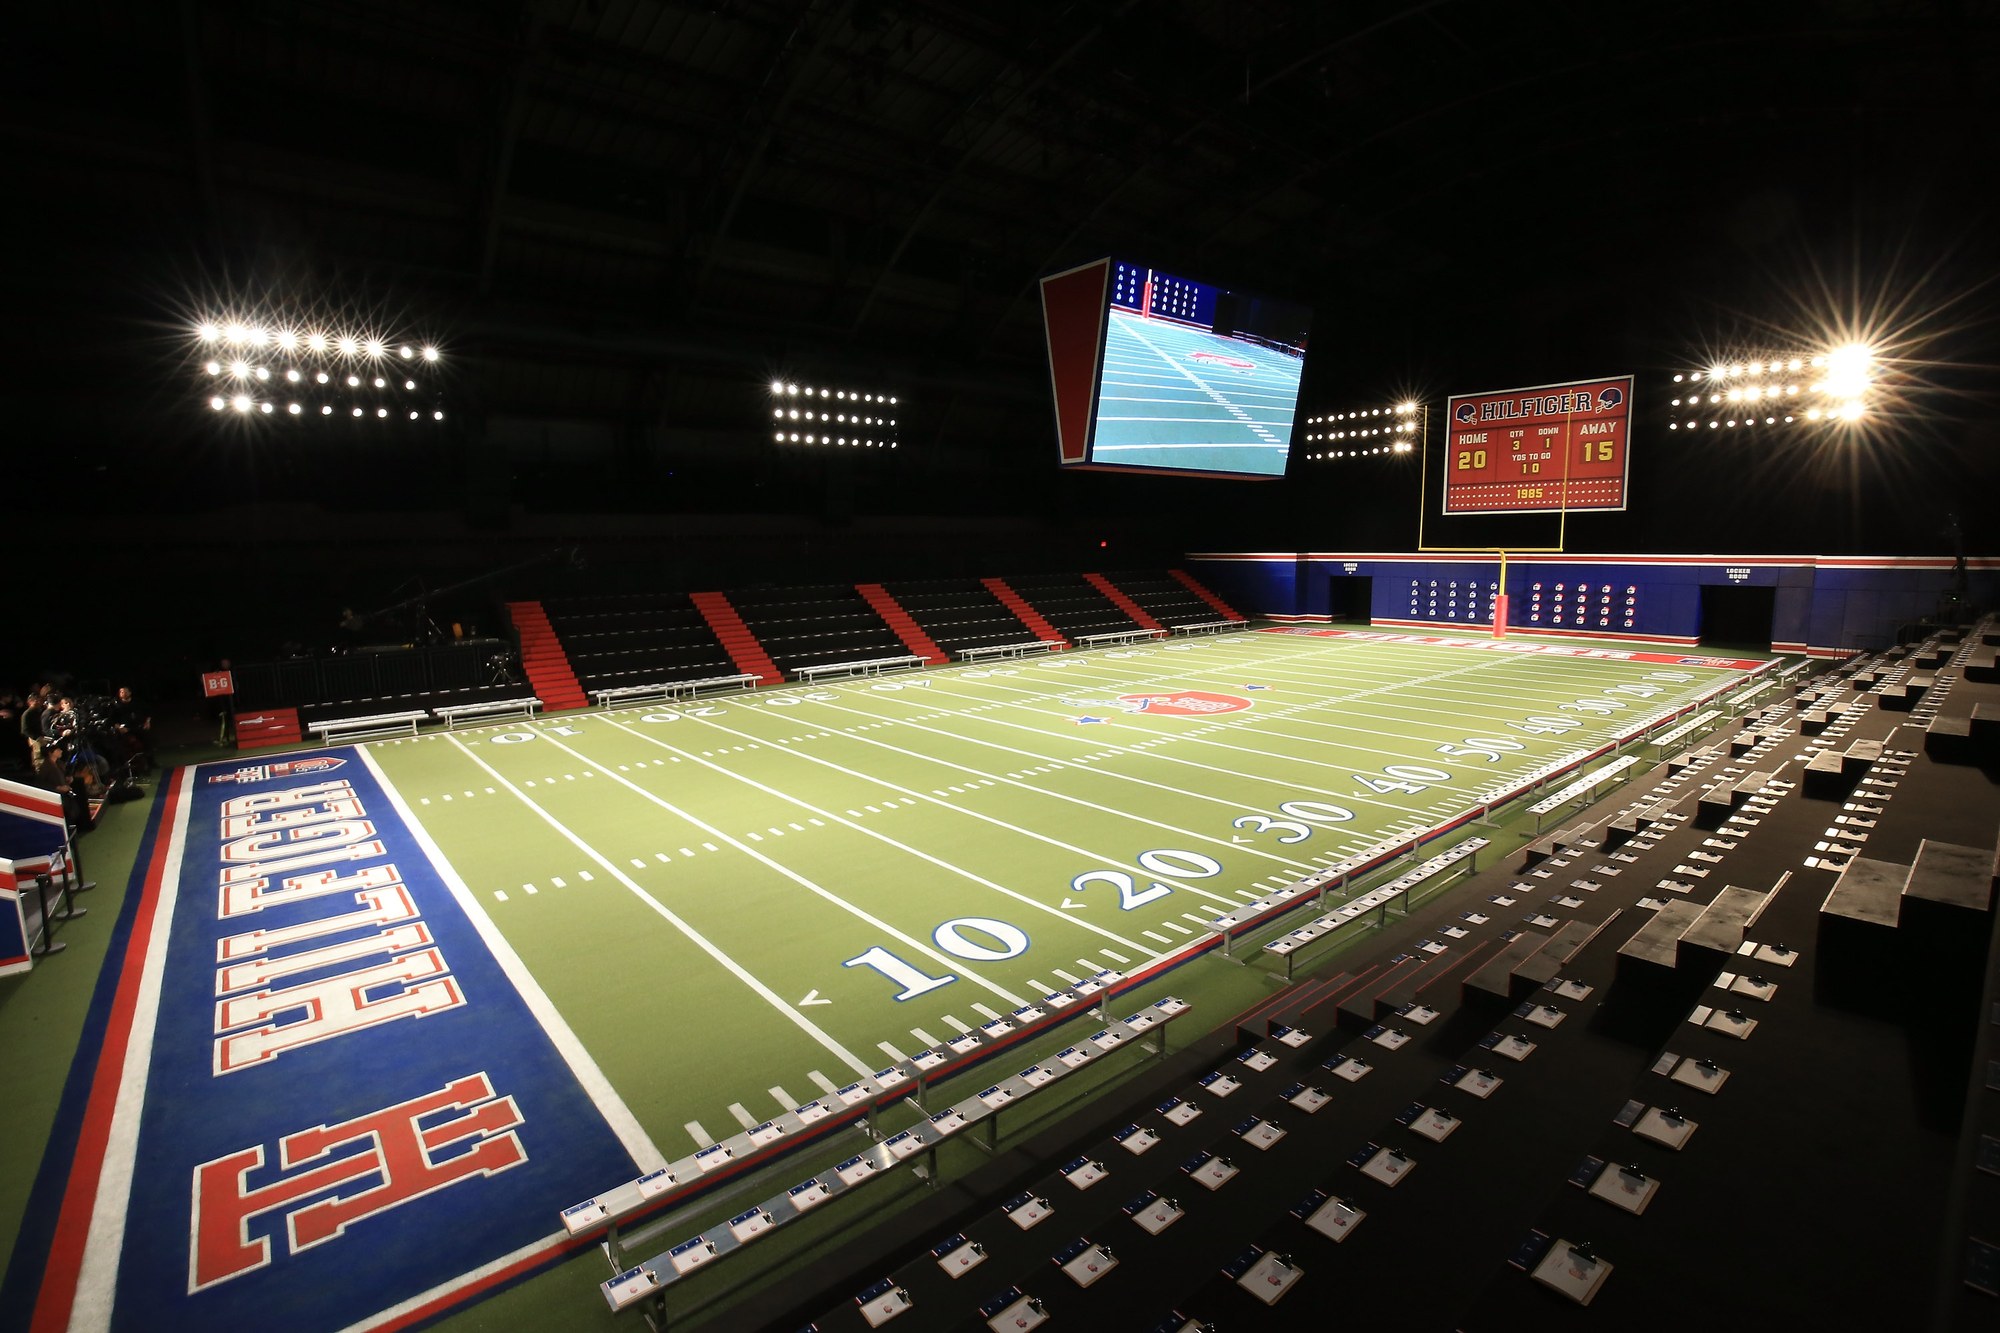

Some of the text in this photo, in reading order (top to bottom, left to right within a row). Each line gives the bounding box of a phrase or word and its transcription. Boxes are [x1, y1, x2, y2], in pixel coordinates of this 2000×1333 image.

[1480, 391, 1592, 422] HILFIGER
[1510, 427, 1559, 438] QTR DOWN
[1580, 422, 1617, 435] AWAY
[1459, 433, 1488, 444] HOME
[1513, 438, 1550, 450] 3 1
[1458, 450, 1486, 470] 20
[1541, 452, 1551, 460] GO
[1584, 441, 1613, 462] 15
[1517, 488, 1543, 499] 1985
[763, 692, 841, 706] 30
[1602, 683, 1665, 698] 20
[639, 706, 728, 723] 20
[1557, 698, 1628, 715] 30
[489, 725, 584, 744] 10
[1505, 715, 1584, 735] 40
[1435, 737, 1526, 762] 50
[1352, 765, 1452, 795] 40
[1232, 801, 1355, 844] 30
[1071, 848, 1223, 911] 20
[212, 779, 467, 1077] HILFIGER
[841, 916, 1031, 1002] 10
